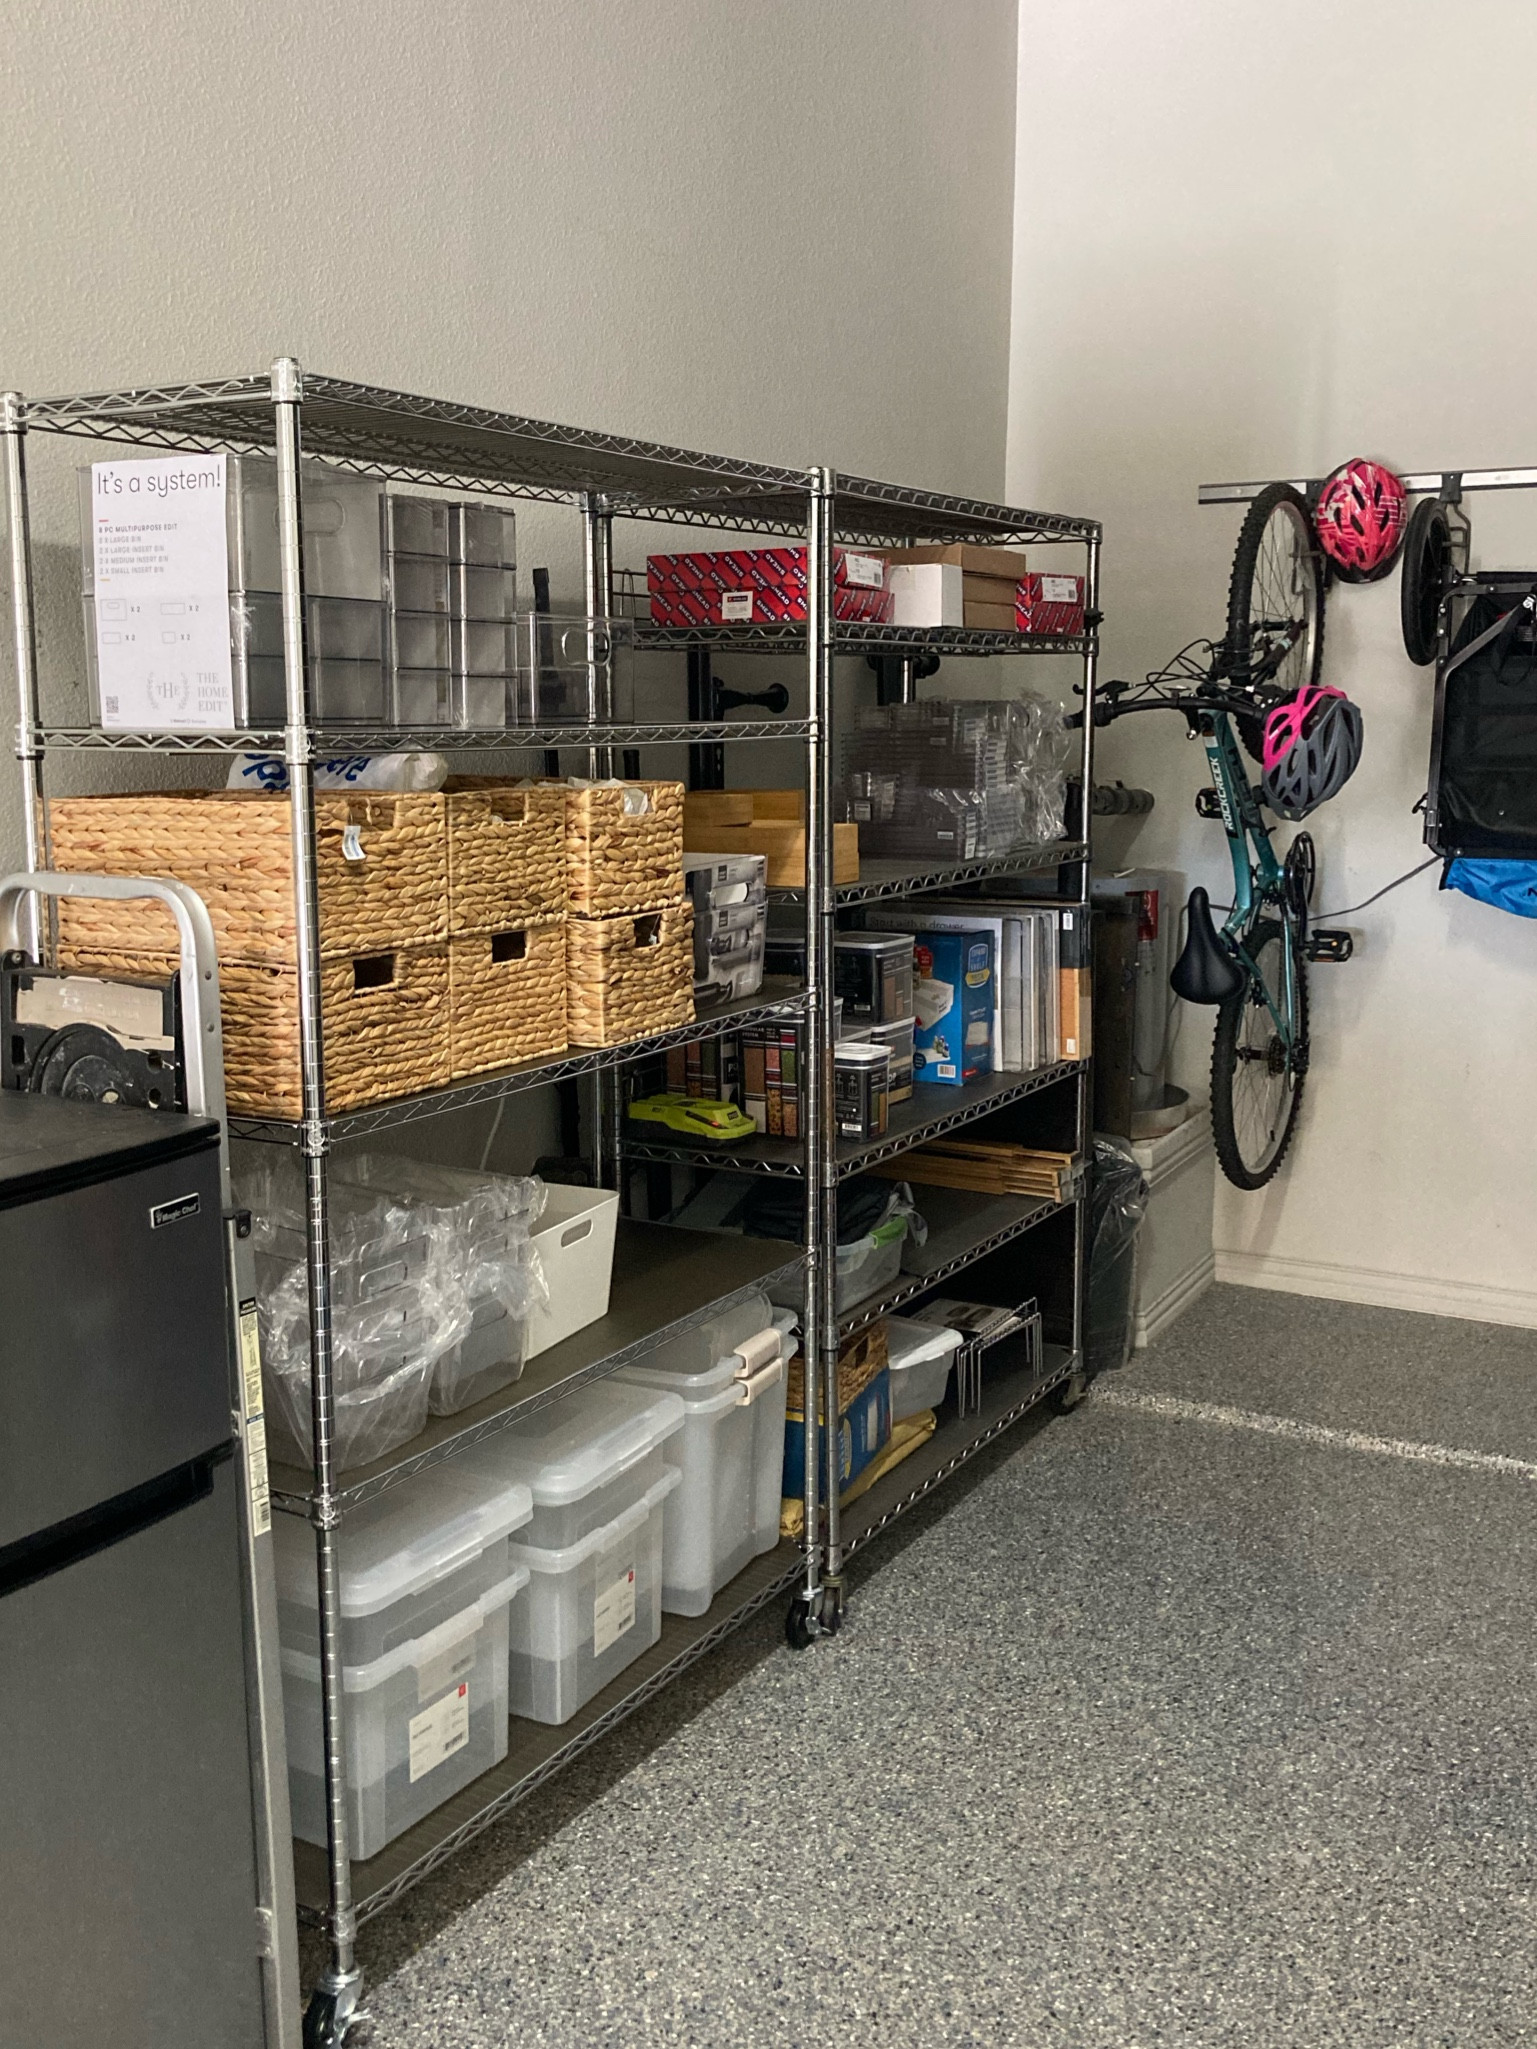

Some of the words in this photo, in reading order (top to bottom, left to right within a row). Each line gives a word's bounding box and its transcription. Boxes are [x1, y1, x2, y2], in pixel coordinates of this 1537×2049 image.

[98, 471, 123, 494] It's
[129, 477, 140, 493] a
[147, 464, 221, 498] system!
[115, 524, 162, 532] MULTIPURPOSE
[110, 536, 130, 544] LARGE
[110, 546, 130, 554] LARGE
[132, 545, 152, 553] INSERT
[110, 556, 135, 564] MEDIUM
[132, 566, 153, 574] INSERT
[756, 600, 776, 621] SMEAD
[196, 672, 219, 684] THE
[197, 686, 228, 698] HOME
[1209, 756, 1234, 830] ROCKCREEK
